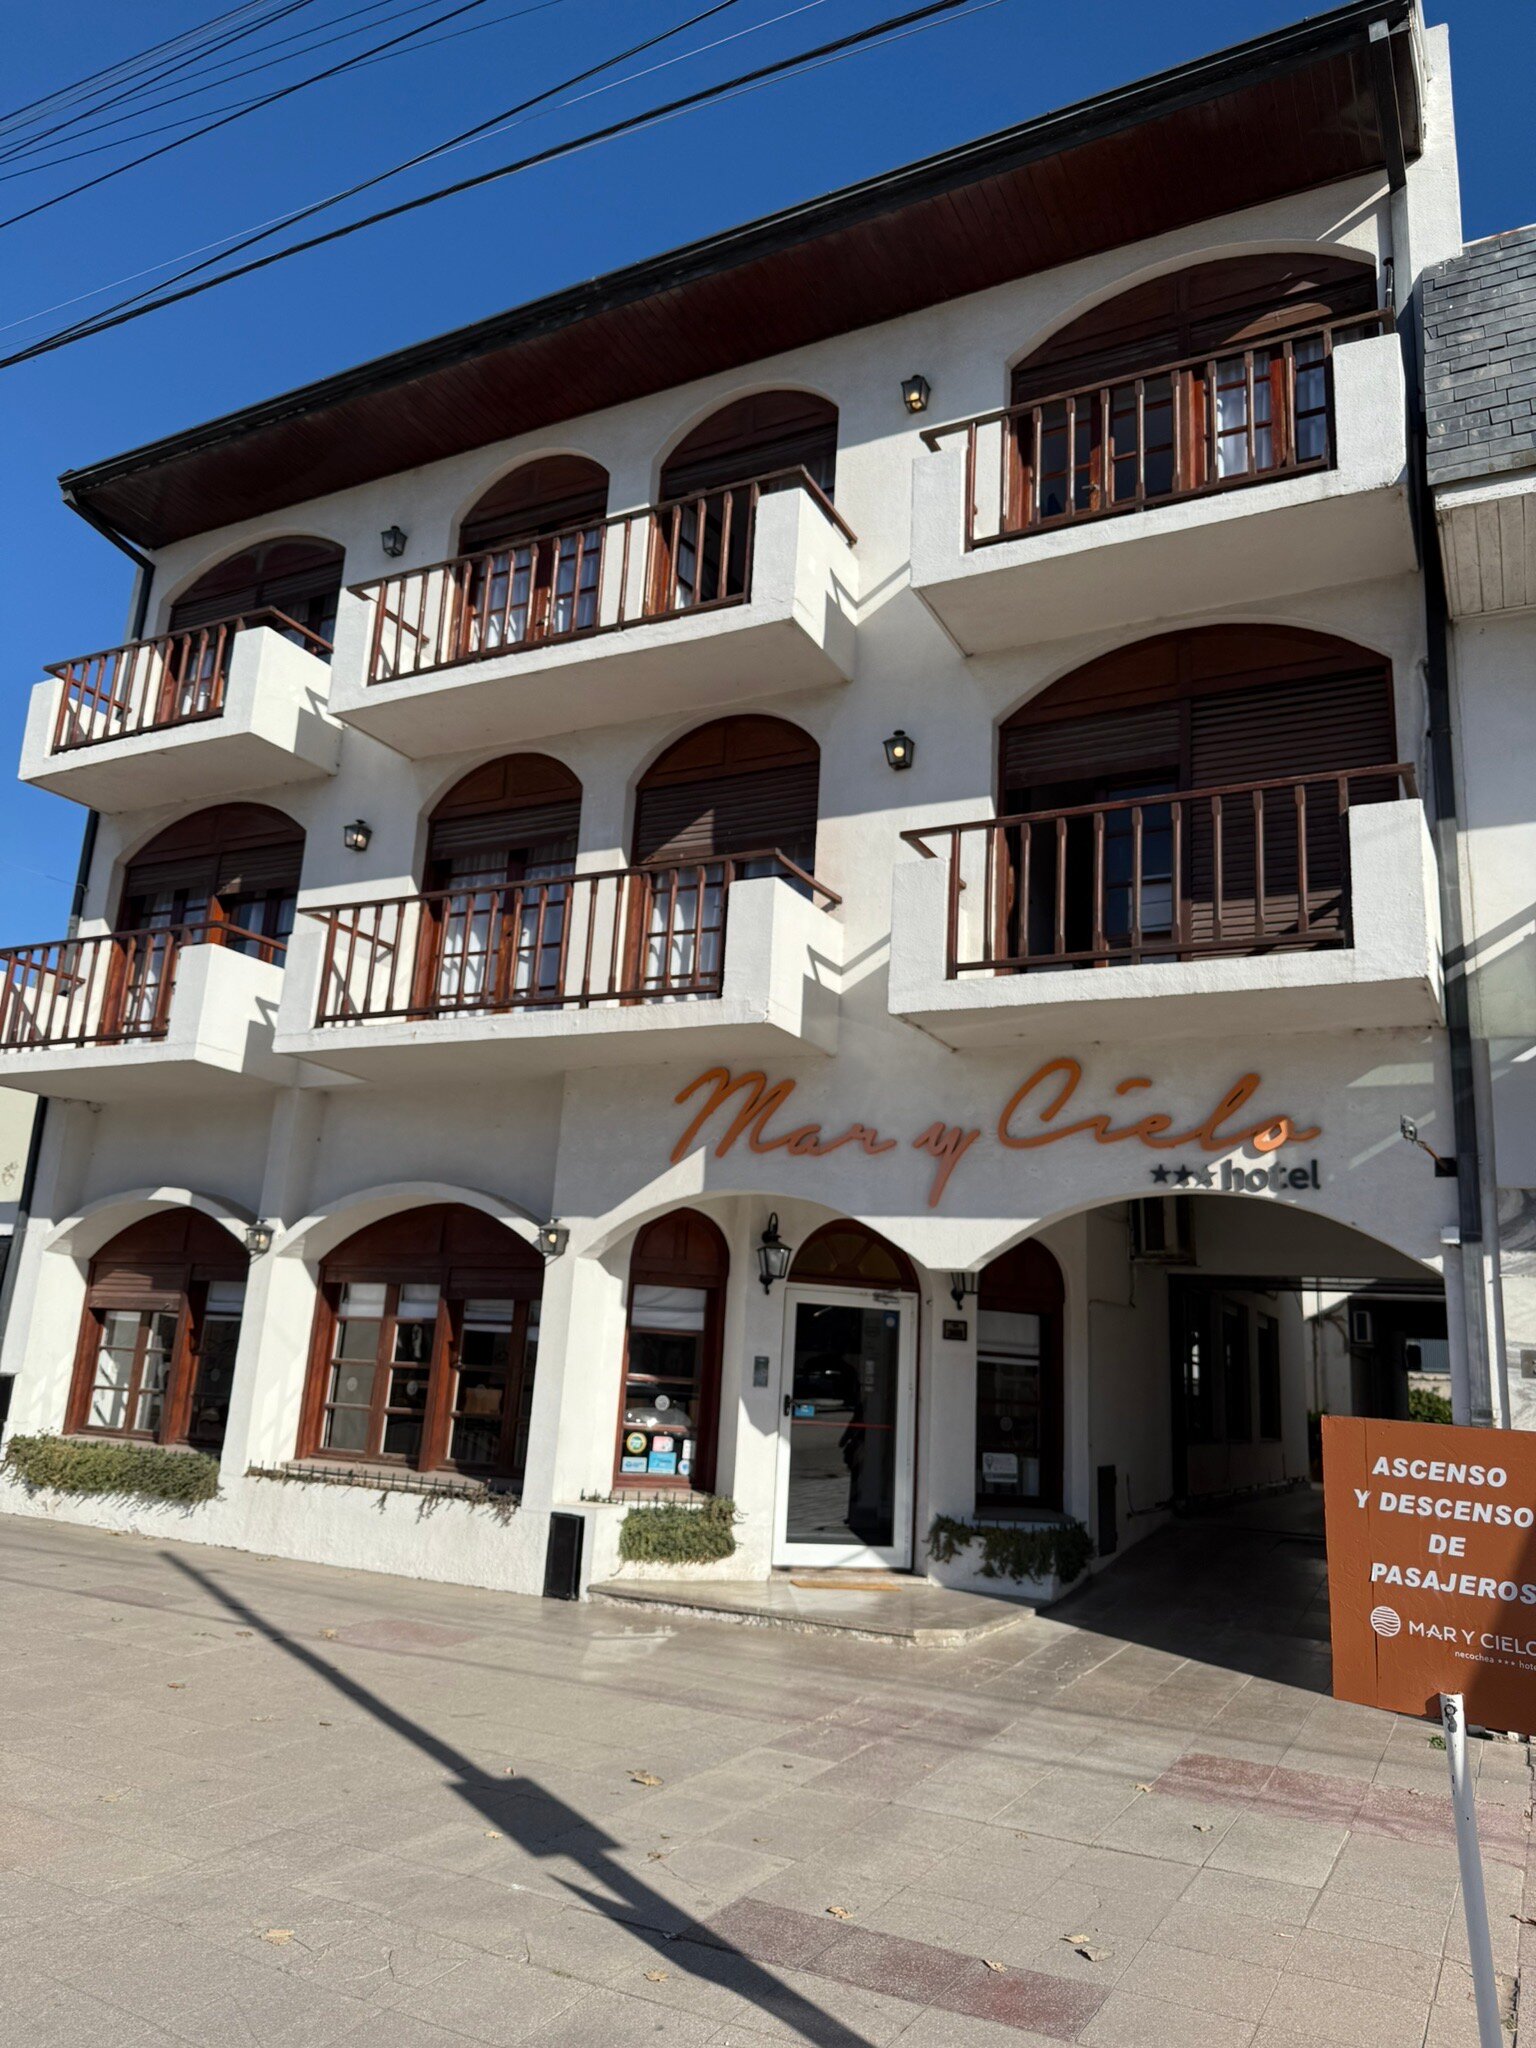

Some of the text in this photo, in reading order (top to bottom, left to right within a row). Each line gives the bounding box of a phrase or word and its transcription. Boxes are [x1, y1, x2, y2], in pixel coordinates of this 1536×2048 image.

[669, 1057, 1322, 1208] Mar y Cielo
[1219, 1158, 1321, 1193] hotel
[1371, 1456, 1507, 1488] ASCENSO
[1353, 1488, 1535, 1528] Y DESCENSO
[1428, 1533, 1467, 1558] DE
[1370, 1562, 1536, 1605] PASAJEROS
[1408, 1620, 1457, 1643] MAR
[1460, 1628, 1475, 1646] Y
[1454, 1650, 1495, 1664] necochea
